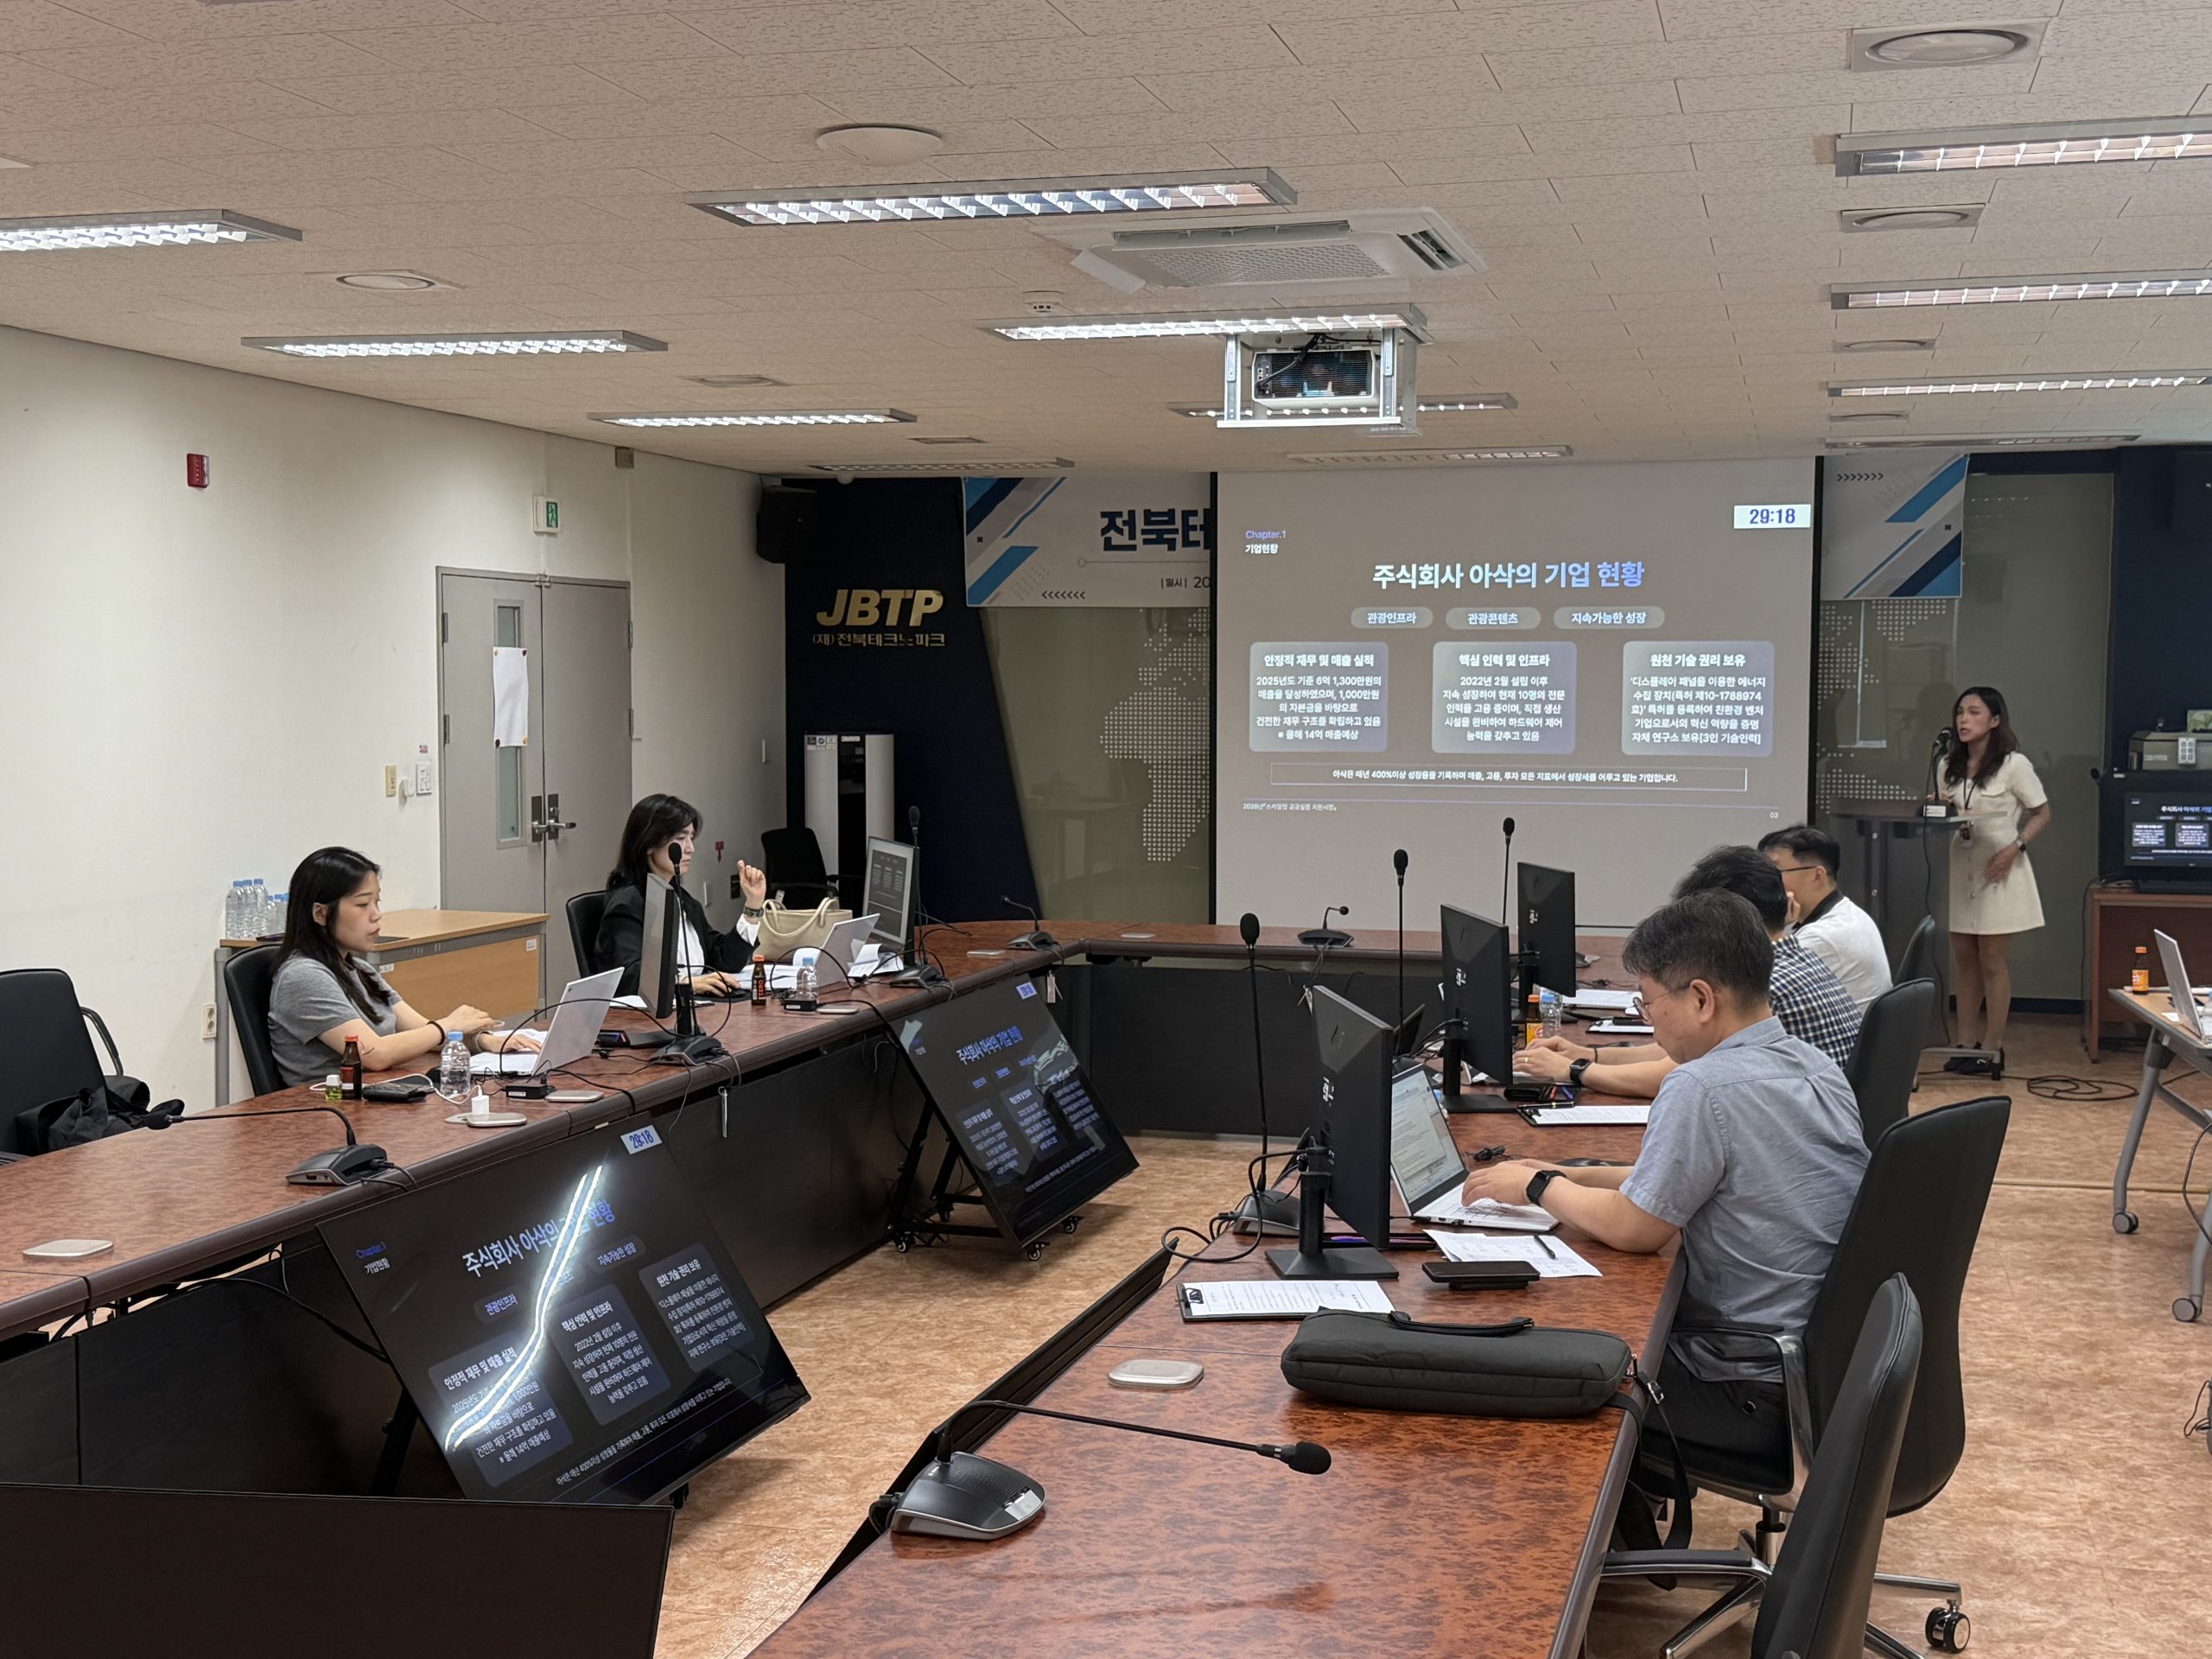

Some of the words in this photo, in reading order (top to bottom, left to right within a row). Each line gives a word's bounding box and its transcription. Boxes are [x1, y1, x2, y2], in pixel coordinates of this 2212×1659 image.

[1750, 508, 1795, 524] 29:18
[1101, 509, 1210, 551] 전북테
[1246, 530, 1286, 539] Chapter.1
[1245, 543, 1278, 554] 기업현황
[1373, 563, 1464, 588] 주식회사
[1470, 563, 1536, 588] 아삭의
[1545, 563, 1590, 588] 기업
[1598, 562, 1644, 588] 현황
[817, 589, 944, 626] JBTP
[1368, 613, 1416, 624] 관광인프라
[1468, 613, 1518, 625] 관광콘텐츠
[1572, 612, 1623, 624] 지속가능한
[1625, 612, 1646, 624] 성장
[1264, 655, 1294, 666] 안정적
[1296, 655, 1316, 666] 재무
[1319, 655, 1329, 666] 및
[1332, 655, 1351, 666] 매출
[1354, 655, 1374, 666] 실적
[1459, 654, 1479, 666] 핵심
[1483, 654, 1503, 666] 인력
[1505, 654, 1516, 666] 및
[1518, 654, 1550, 666] 인프라
[1650, 654, 1672, 666] 원천
[1675, 654, 1696, 666] 기술
[1699, 654, 1720, 666] 권리
[1723, 654, 1745, 666] 보유
[1256, 677, 1295, 686] 2025년도
[1298, 677, 1313, 686] 기준
[1316, 677, 1330, 686] 6억
[1333, 677, 1381, 686] 1,300만원의
[1460, 677, 1491, 686] 2022년
[1495, 677, 1508, 686] 2월
[1511, 677, 1528, 686] 설립
[1531, 677, 1548, 686] 이후
[1679, 677, 1706, 687] 패널을
[1708, 677, 1735, 687] 이용한
[1738, 677, 1765, 687] 에너지
[1258, 690, 1281, 700] 매출을
[1339, 690, 1379, 700] 1,000만원
[1443, 690, 1459, 700] 지속
[1518, 690, 1545, 700] 10명의
[1548, 690, 1565, 700] 전문
[1634, 691, 1650, 702] 수집
[1280, 703, 1287, 713] 의
[1289, 703, 1322, 713] 자본금을
[1325, 703, 1357, 713] 바탕으로
[1446, 703, 1471, 714] 인력을
[1474, 703, 1491, 714] 고용
[1524, 703, 1541, 714] 직접
[1544, 703, 1561, 714] 생산
[1649, 705, 1674, 715] 특허를
[1677, 705, 1713, 715] 등록하여
[1715, 705, 1742, 715] 친환경
[1745, 705, 1764, 715] 벤처
[1256, 717, 1281, 727] 건전한
[1283, 717, 1299, 727] 재무
[1302, 717, 1325, 727] 구조를
[1445, 717, 1469, 728] 시설을
[1509, 717, 1542, 728] 하드웨어
[1545, 717, 1562, 728] 제어
[1635, 719, 1688, 729] 기업으로서의
[1690, 719, 1707, 729] 혁신
[1741, 719, 1759, 729] 증명
[1305, 730, 1322, 740] 14억
[1466, 731, 1491, 741] 능력을
[1495, 731, 1520, 741] 갖추고
[1522, 731, 1539, 741] 있음
[1632, 733, 1649, 743] 자체
[1653, 733, 1679, 743] 연구소
[629, 1130, 654, 1149] 29:18
[462, 1235, 524, 1277] 주식회사
[520, 1220, 560, 1253] 아삭의
[485, 1293, 518, 1316] 관광인프라
[594, 1301, 613, 1318] 인프라
[444, 1370, 468, 1390] 안정적
[465, 1362, 481, 1378] 재무
